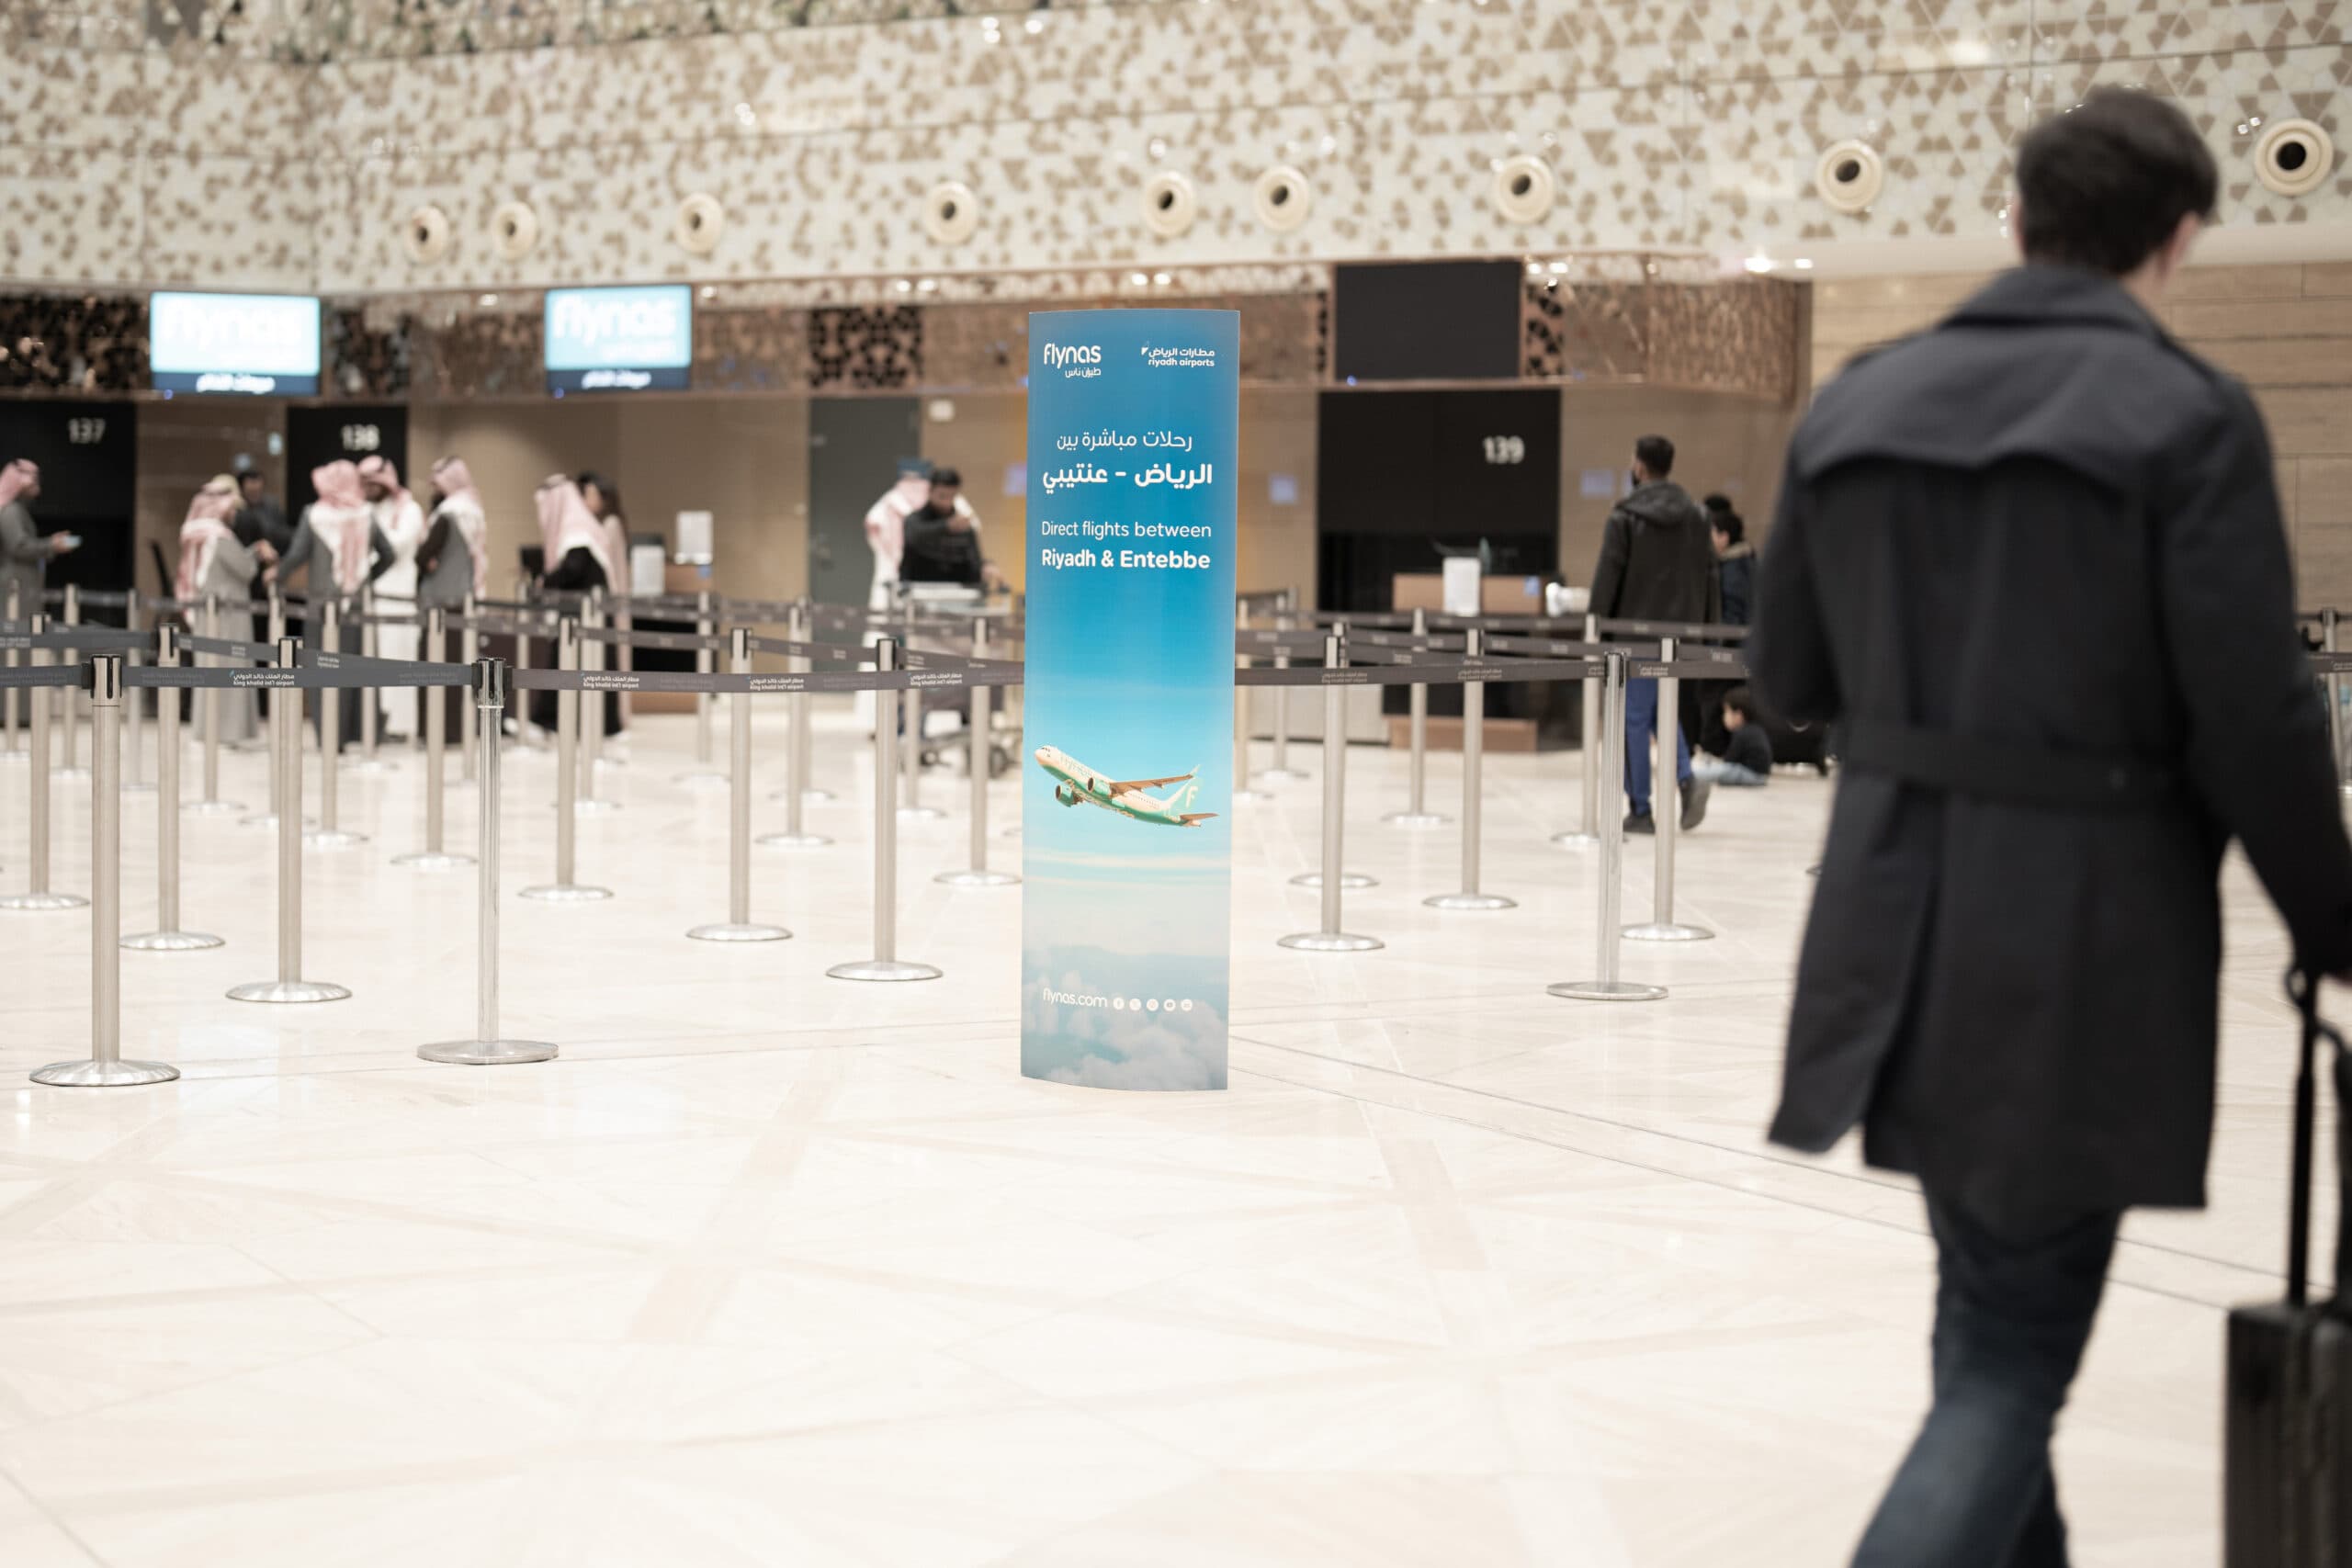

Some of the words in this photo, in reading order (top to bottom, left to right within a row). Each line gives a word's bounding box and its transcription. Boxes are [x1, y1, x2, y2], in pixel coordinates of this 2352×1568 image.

[1043, 343, 1102, 369] flynas
[1148, 346, 1178, 357] الرياض
[1148, 357, 1178, 367] riyadh
[1179, 358, 1215, 367] airports
[1180, 347, 1216, 357] مطارات
[1065, 367, 1080, 378] ناس
[1081, 367, 1102, 378] طيران
[68, 418, 106, 444] 137
[341, 423, 380, 451] 138
[1081, 428, 1137, 451] مباشرة
[1142, 430, 1193, 453] رحلات
[1057, 434, 1079, 451] بين
[1483, 434, 1524, 464] 139
[1042, 462, 1108, 494] عنتيبي
[1134, 462, 1213, 490] الرياض
[1042, 520, 1079, 536] Direct
[1081, 520, 1129, 540] flights
[1135, 521, 1212, 537] between
[1042, 548, 1096, 570] Riyadh
[1101, 549, 1114, 568] &
[1120, 549, 1211, 569] Entebbe
[1043, 987, 1108, 1008] flynas.com
